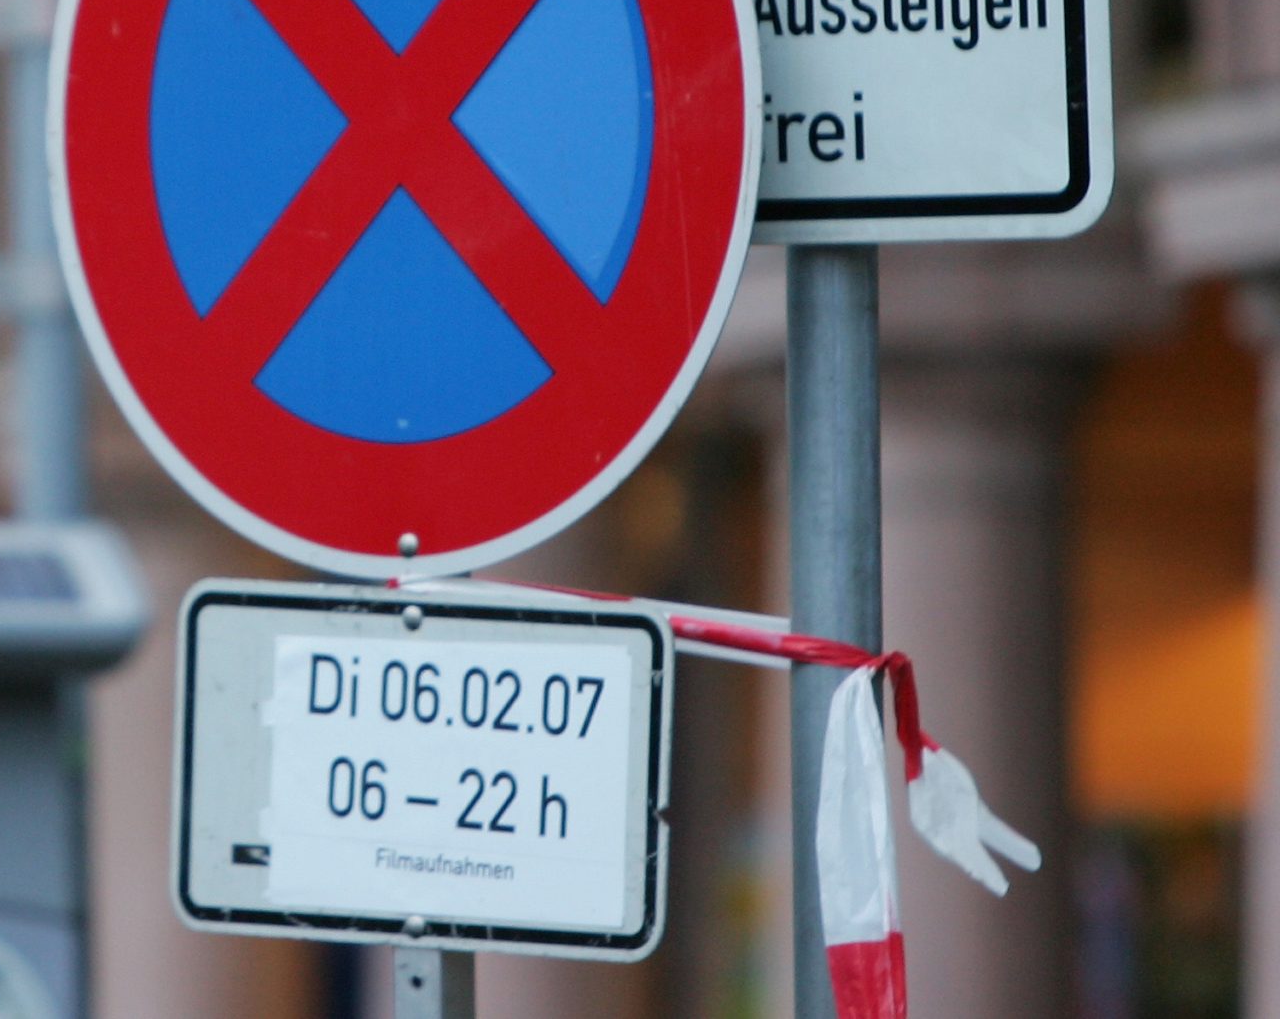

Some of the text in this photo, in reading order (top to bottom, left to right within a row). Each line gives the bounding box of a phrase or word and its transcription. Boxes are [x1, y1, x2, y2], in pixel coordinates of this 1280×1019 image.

[308, 653, 606, 739] Di 06.02.07
[327, 756, 388, 821] 06
[456, 768, 519, 834] 22
[539, 774, 569, 840] h
[375, 847, 515, 881] Filmaufnahmen
